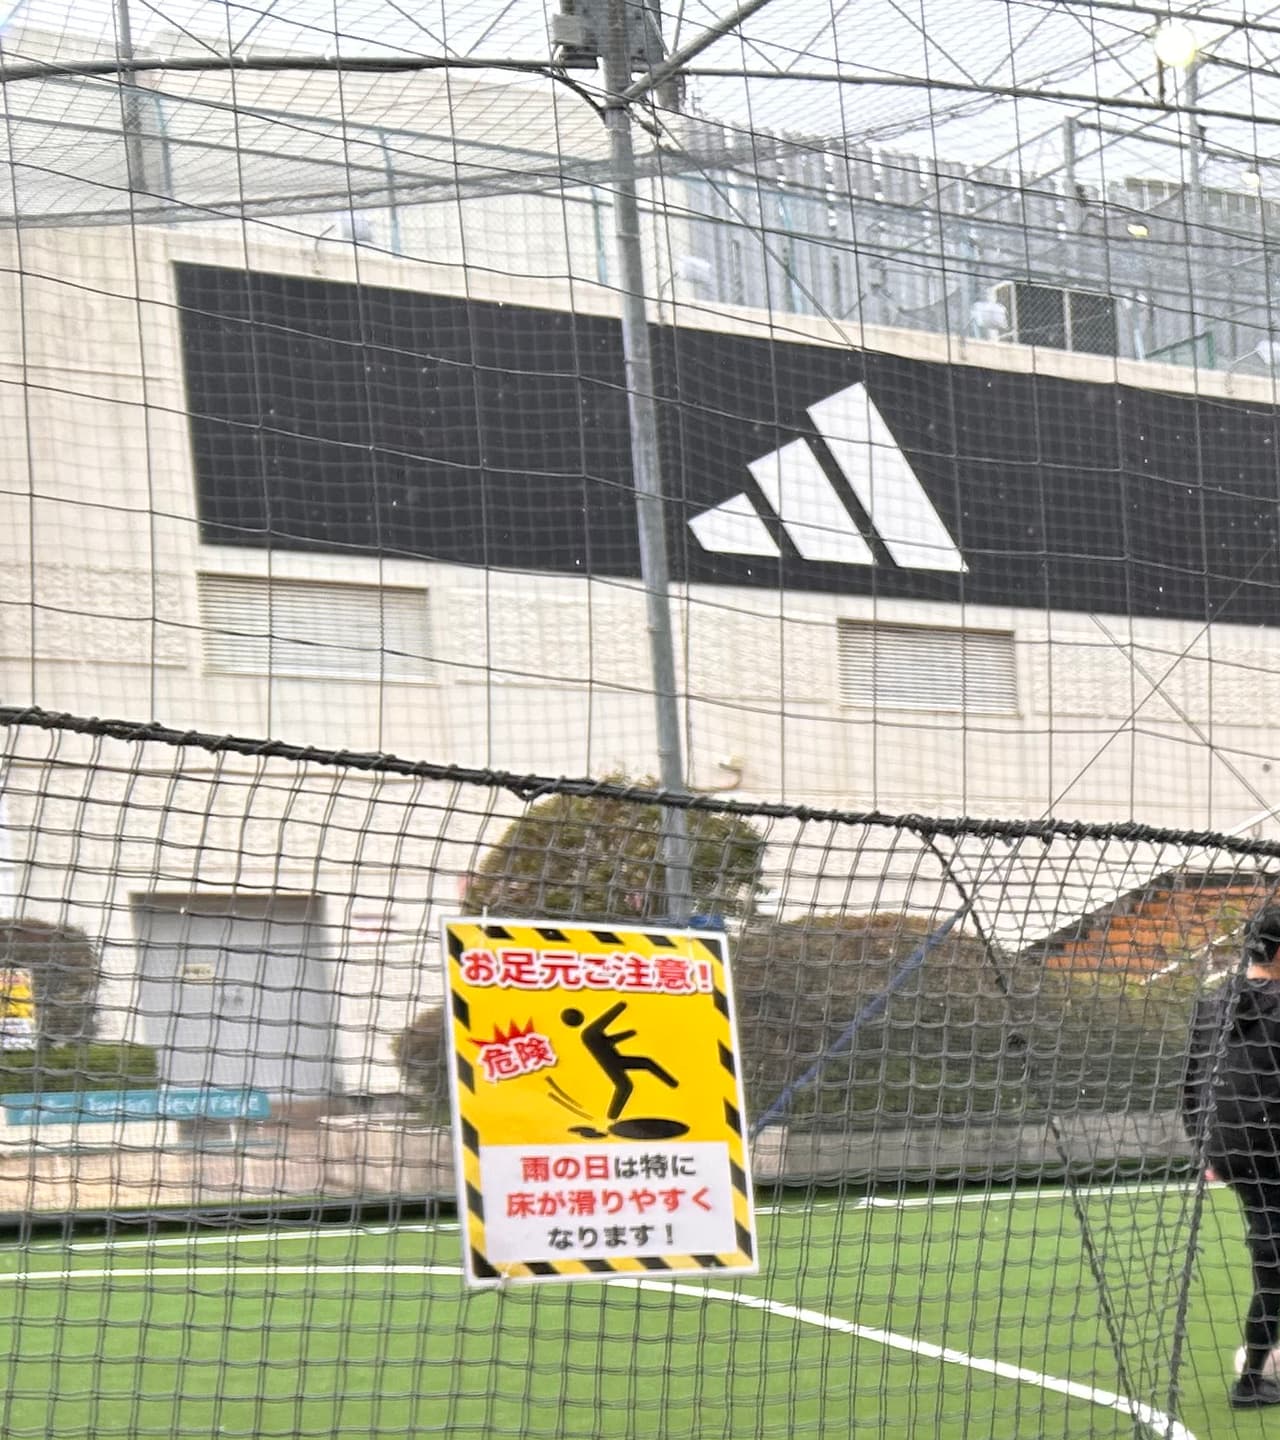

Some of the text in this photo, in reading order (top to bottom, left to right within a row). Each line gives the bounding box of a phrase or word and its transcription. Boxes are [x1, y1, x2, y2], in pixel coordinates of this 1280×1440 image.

[463, 952, 712, 990] お足元ご注意!
[480, 1036, 553, 1080] 危険
[520, 1154, 698, 1182] 雨の日は特に
[505, 1187, 715, 1217] 床が滑りやすく
[547, 1223, 674, 1249] なります！
